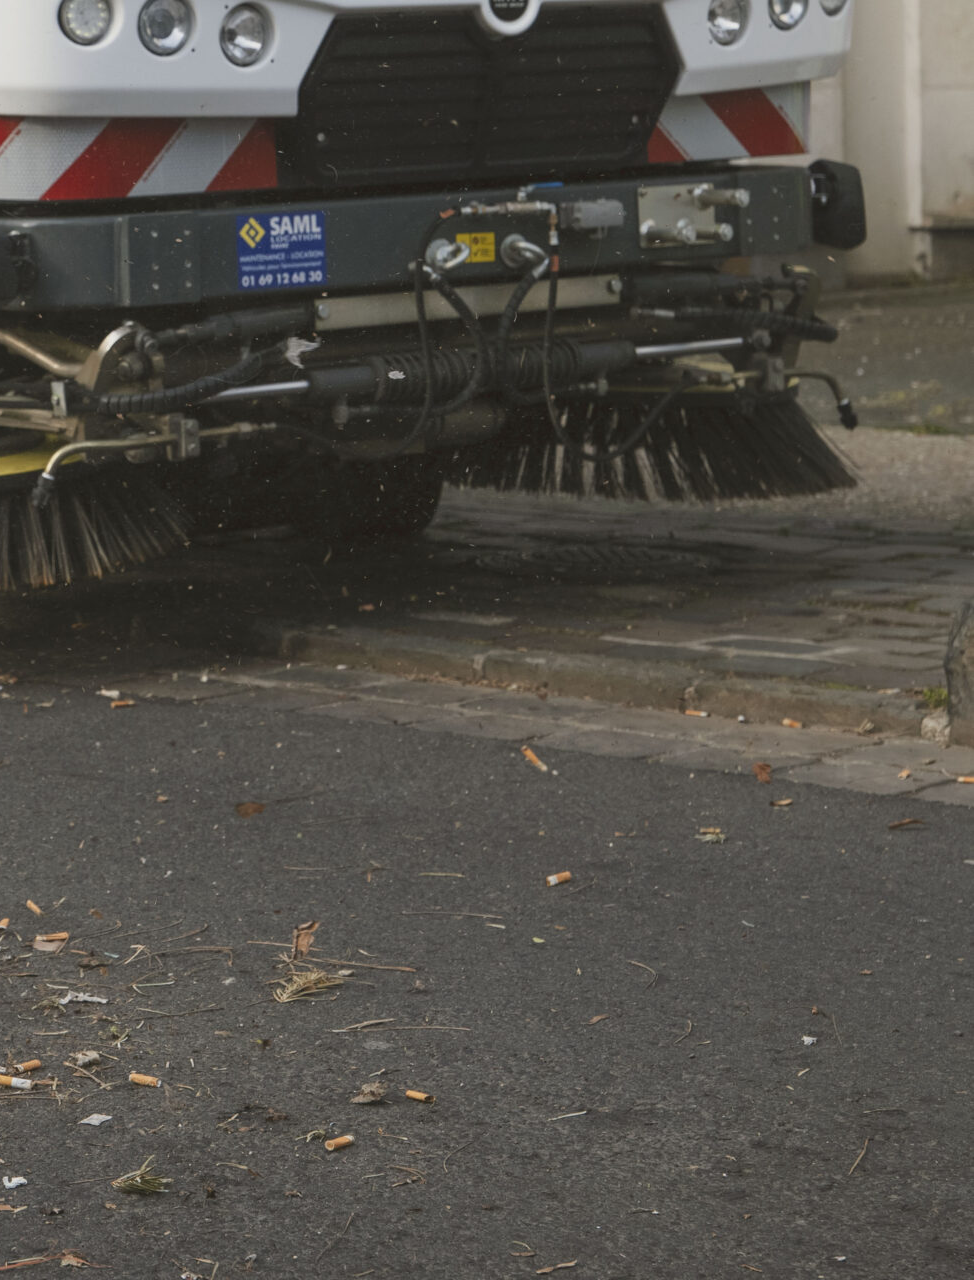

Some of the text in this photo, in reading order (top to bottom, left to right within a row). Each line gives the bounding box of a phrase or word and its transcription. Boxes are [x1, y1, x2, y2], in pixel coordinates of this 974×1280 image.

[269, 214, 322, 236] SAML
[270, 233, 322, 243] LOCATION
[241, 269, 323, 288] 01 69 12 68 30
